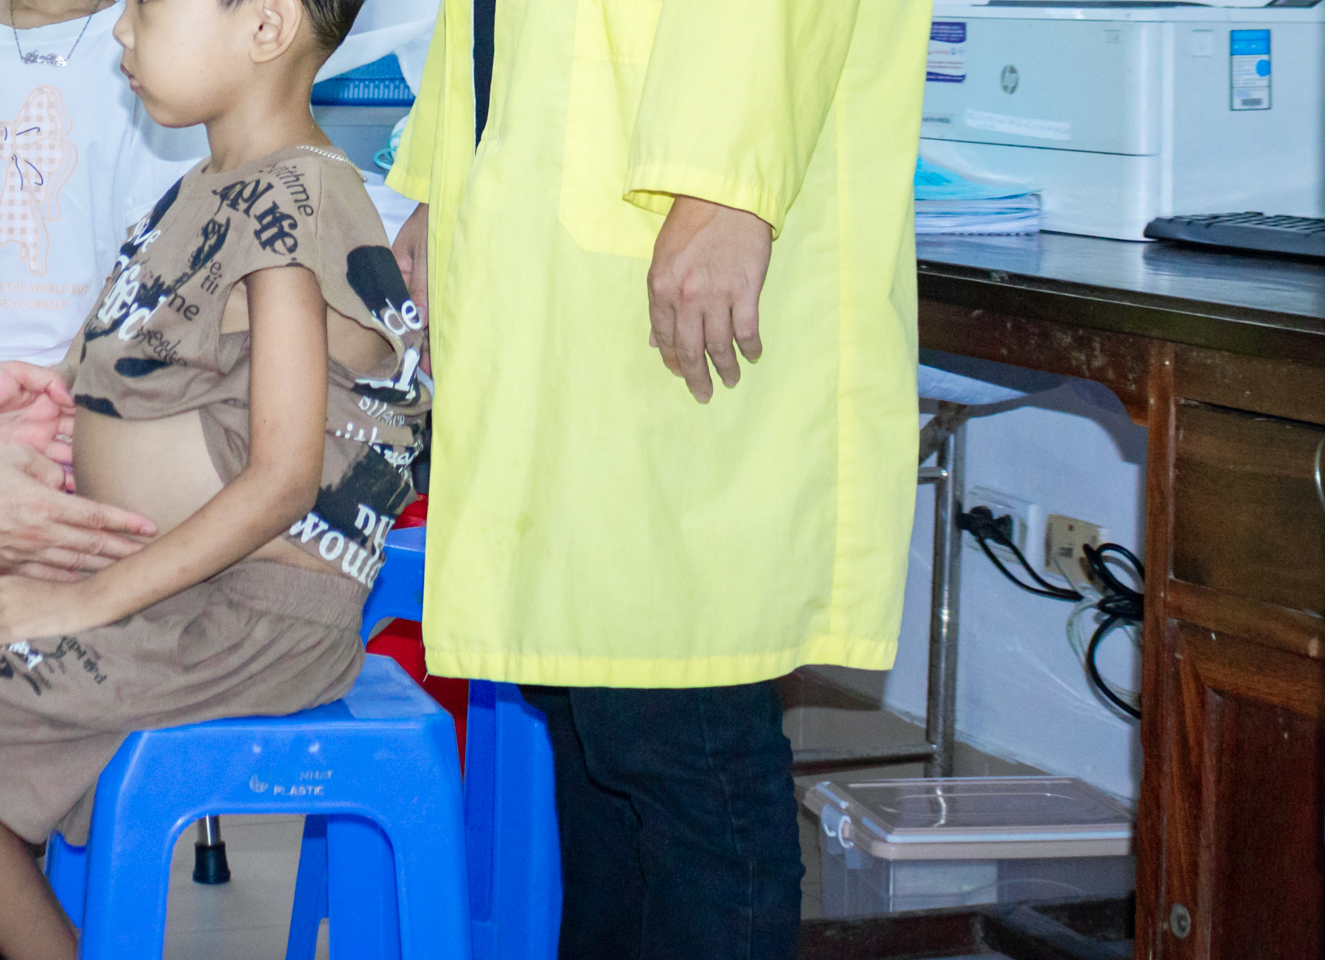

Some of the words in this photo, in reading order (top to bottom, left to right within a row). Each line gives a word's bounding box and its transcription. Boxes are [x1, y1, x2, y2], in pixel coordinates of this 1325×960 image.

[6, 283, 27, 293] THE
[29, 283, 69, 294] WORLD
[71, 284, 91, 295] BUT
[11, 299, 68, 310] YOURSELF
[273, 784, 326, 796] PLASTIC
